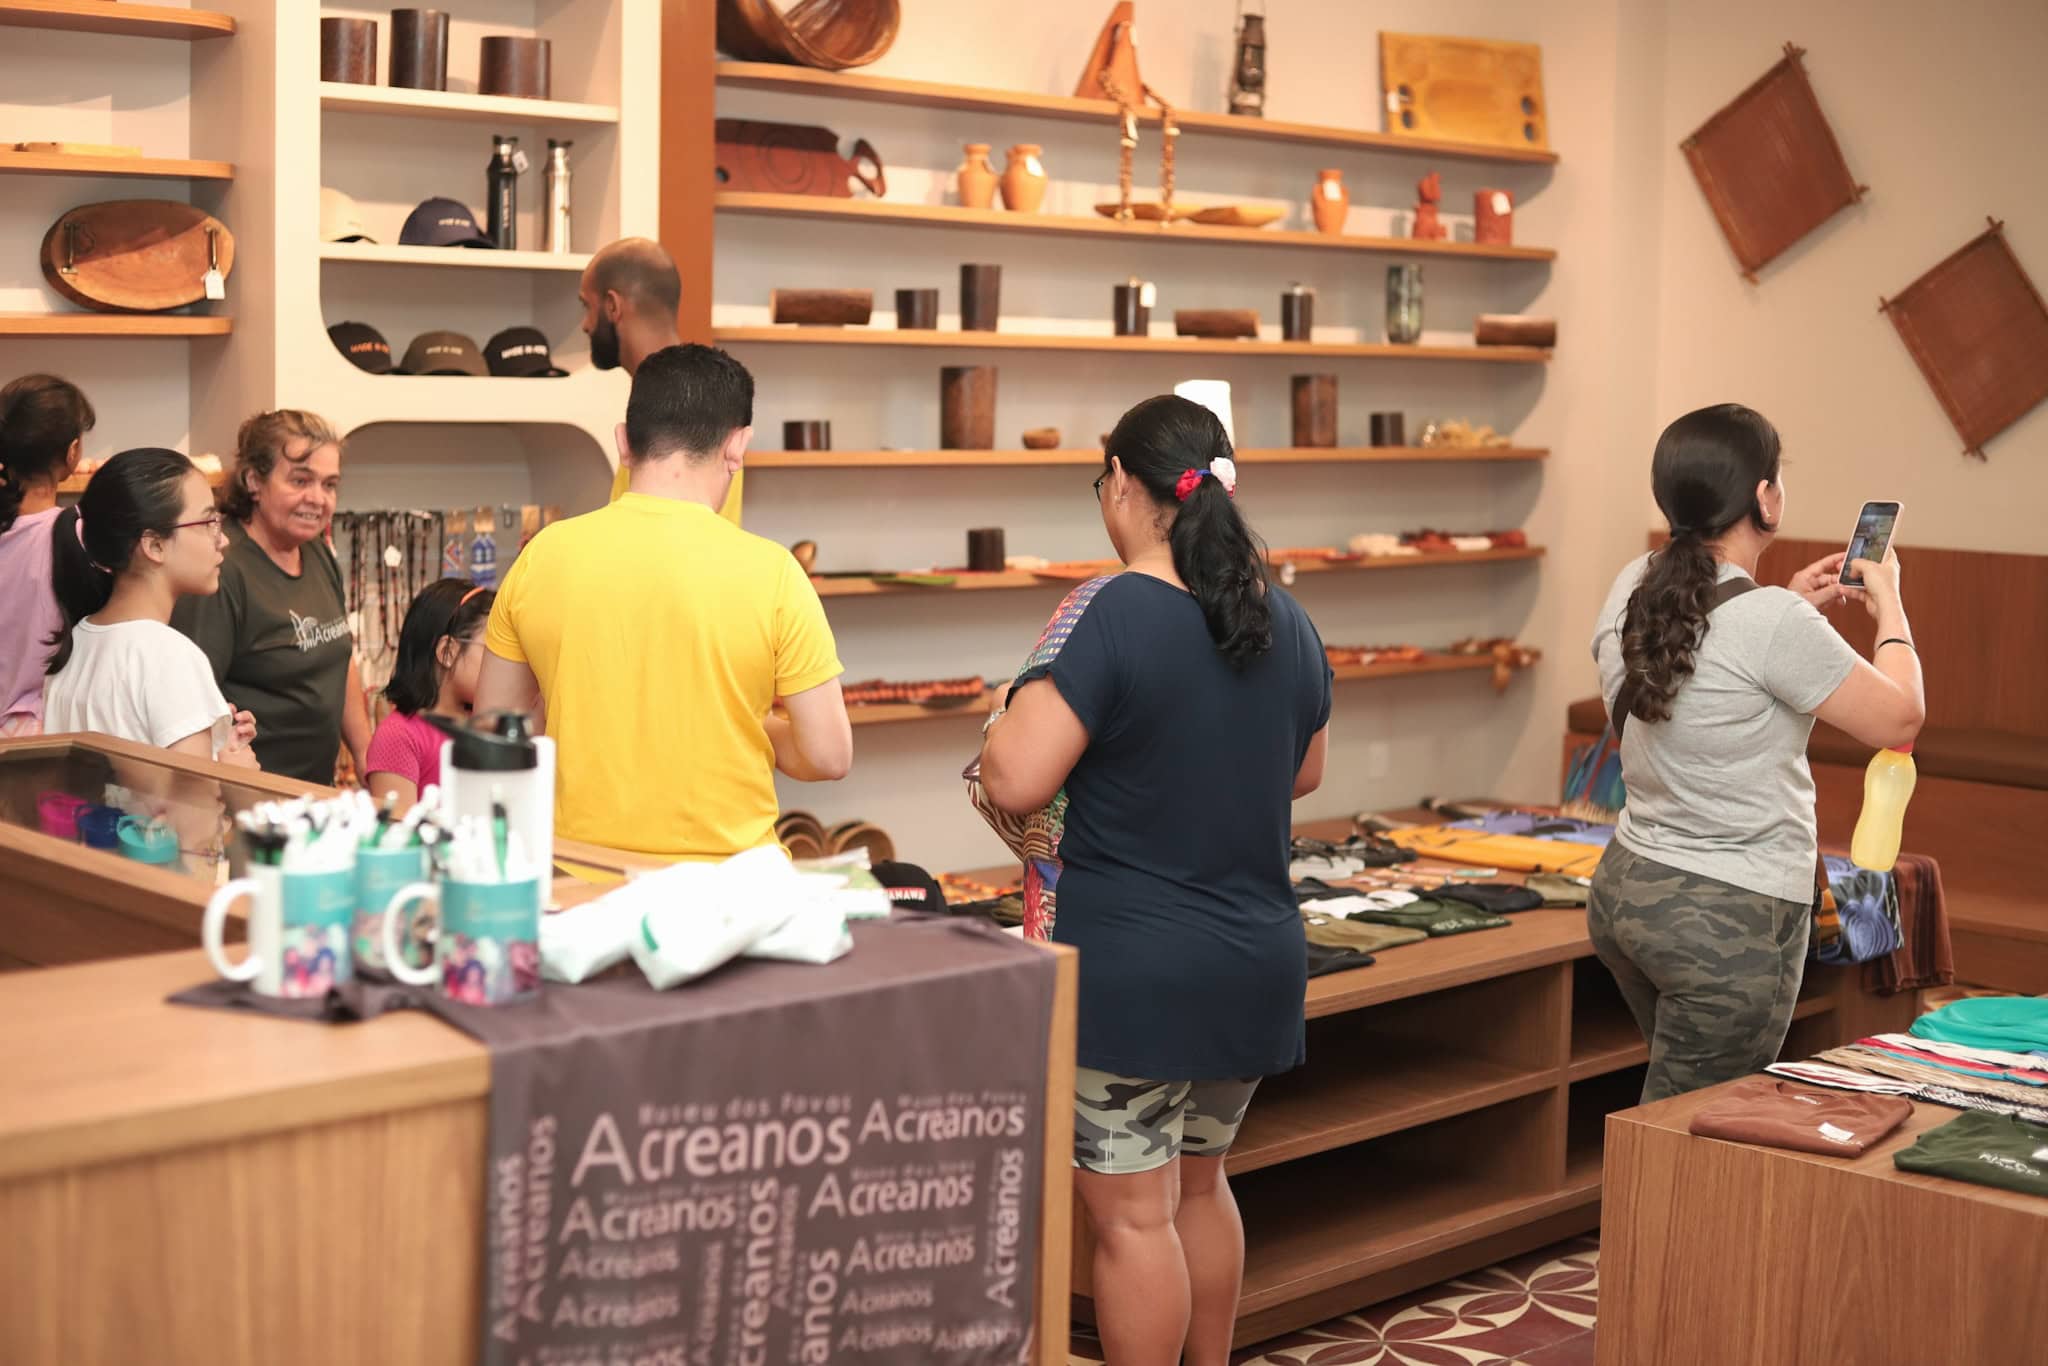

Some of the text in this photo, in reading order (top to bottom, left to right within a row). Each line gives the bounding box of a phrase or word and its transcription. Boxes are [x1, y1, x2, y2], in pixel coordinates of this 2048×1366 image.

[858, 1098, 1026, 1145] Acreanos
[570, 1112, 851, 1187] Acreanos
[807, 1172, 975, 1219] Acreanos
[560, 1196, 738, 1246] Acreanos
[985, 1149, 1025, 1309] Acreanos
[844, 1235, 975, 1277] Acreanos
